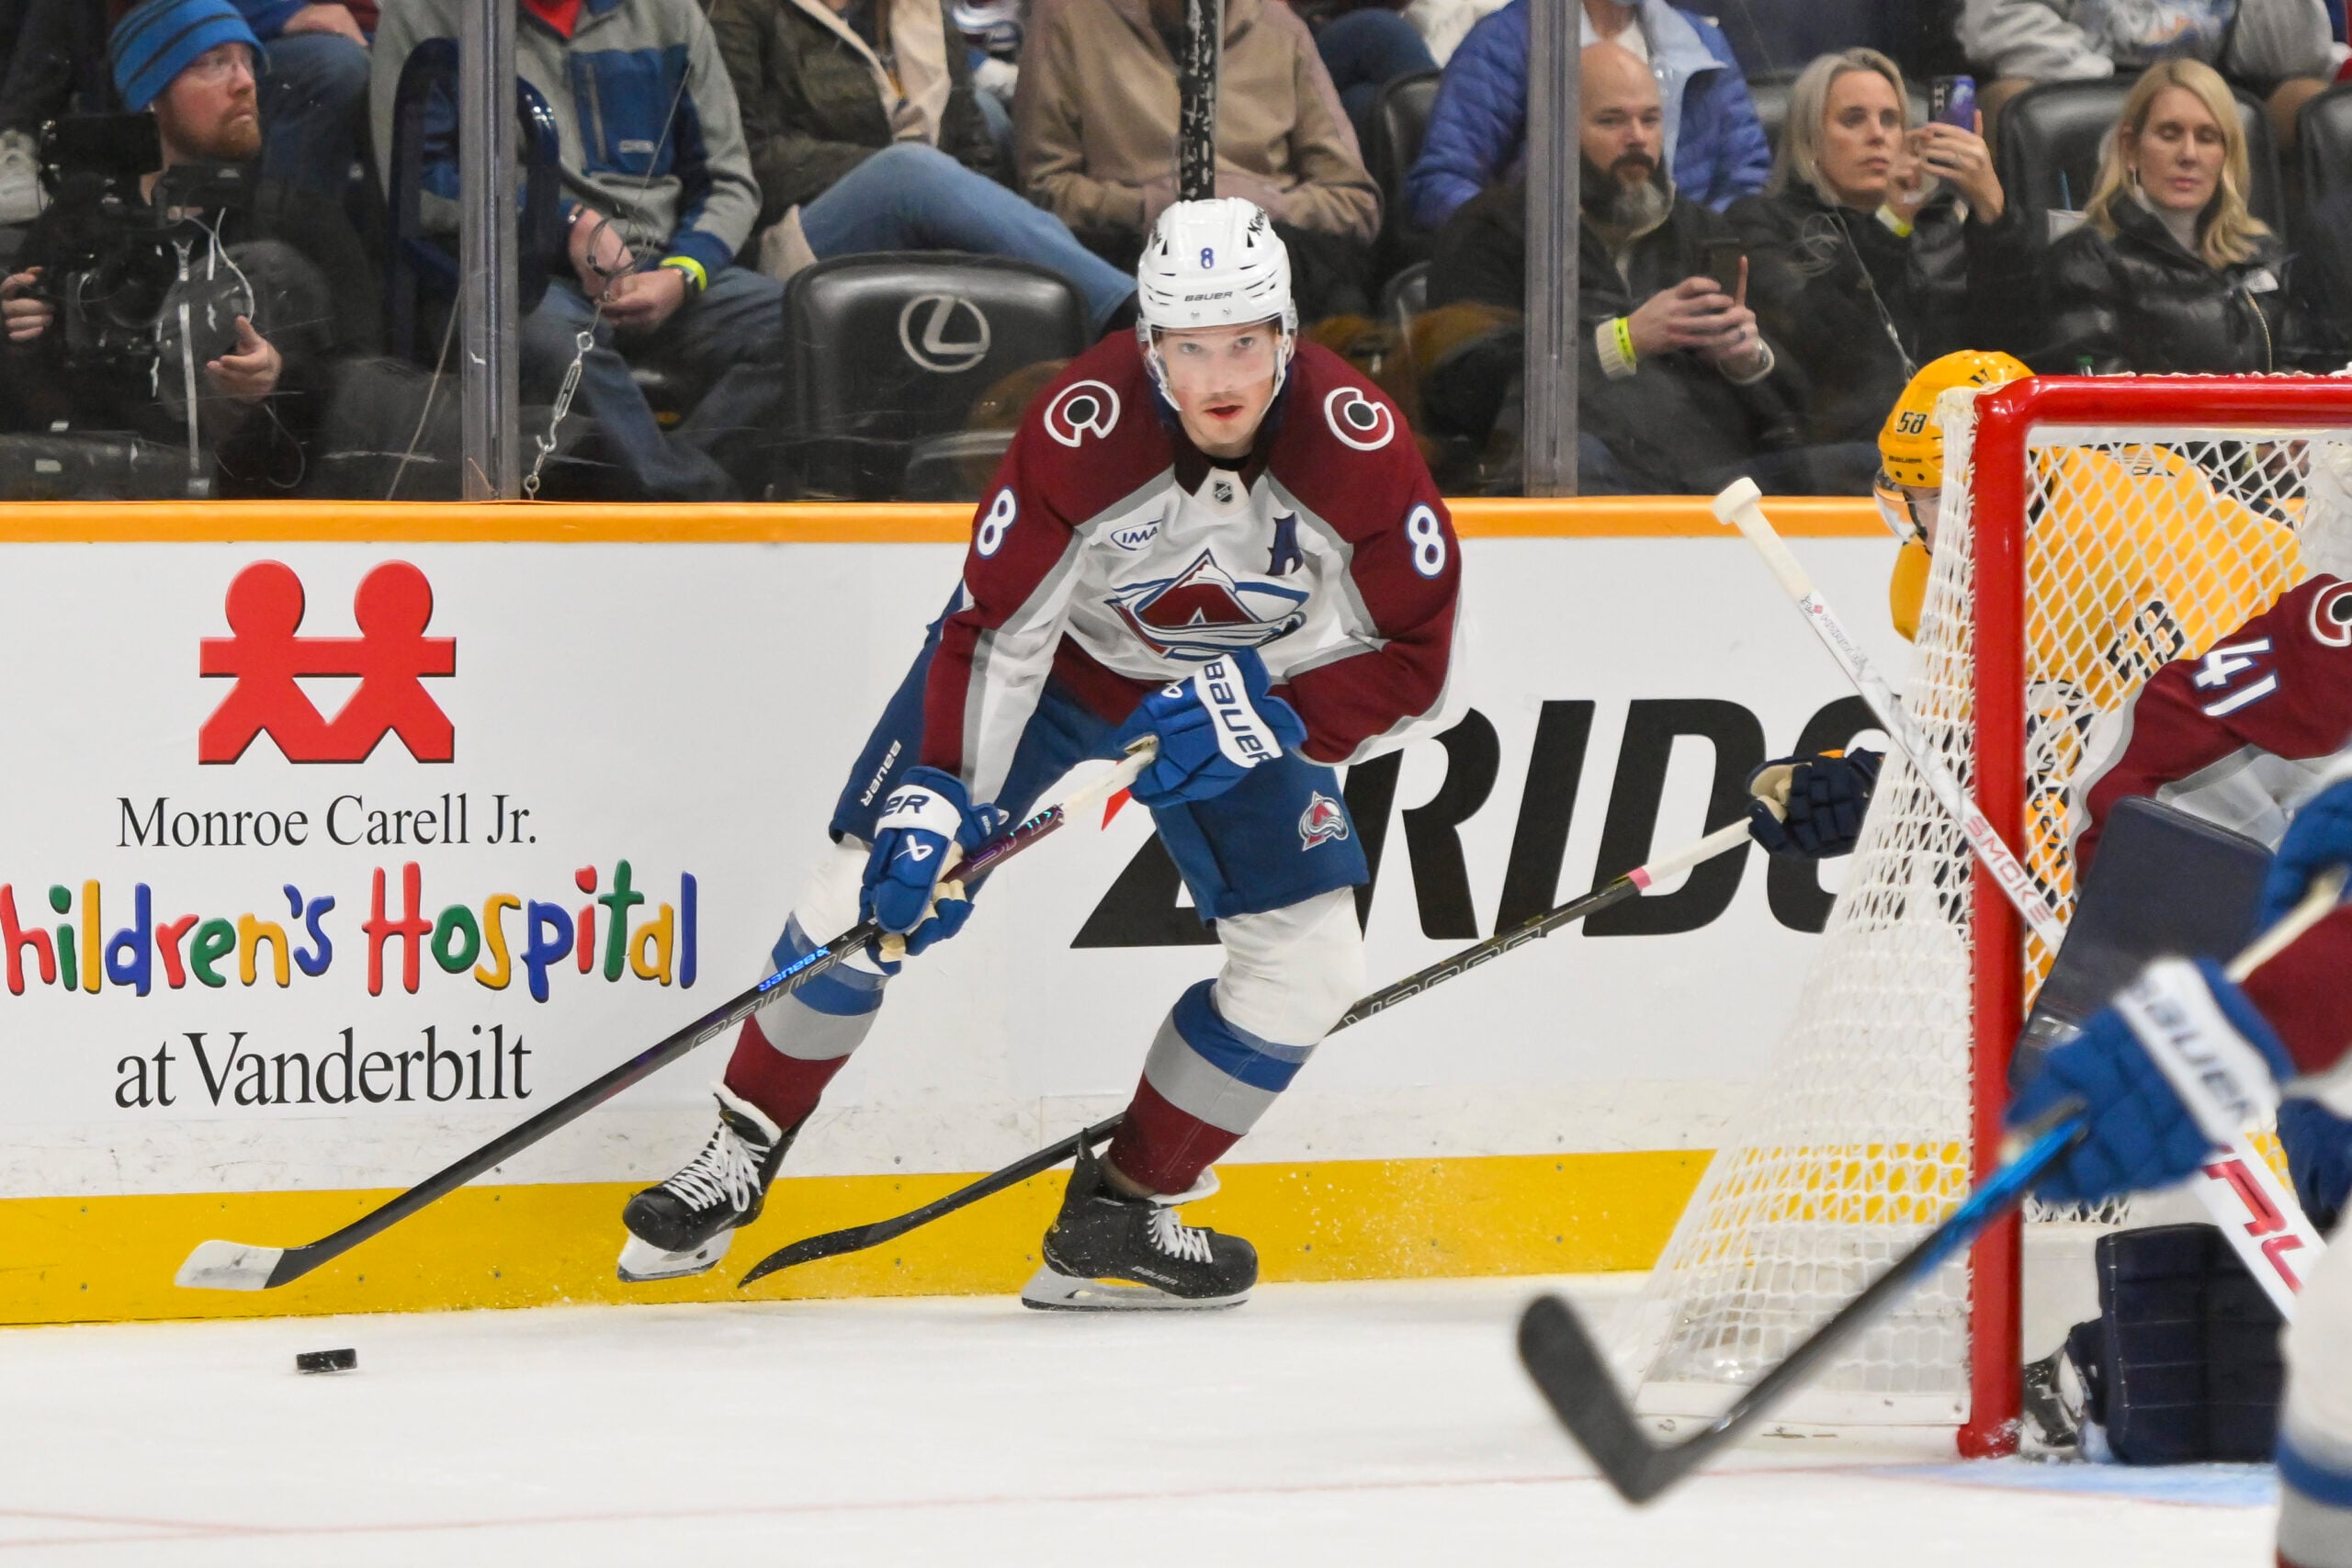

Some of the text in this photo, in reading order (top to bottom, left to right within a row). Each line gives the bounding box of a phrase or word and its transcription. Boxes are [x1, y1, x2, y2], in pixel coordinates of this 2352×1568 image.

[1201, 247, 1214, 269] 8
[1185, 291, 1233, 301] BAUER
[1896, 412, 1927, 434] 58
[977, 486, 1018, 560] 8
[1265, 511, 1304, 576] A
[1405, 502, 1447, 579] 8
[2194, 634, 2279, 719] 41
[860, 739, 902, 807] BAUER
[116, 794, 537, 848] Monroe Carell Jr.
[1965, 815, 2056, 924] SMOKE
[362, 860, 697, 1004] Hospital
[116, 1023, 533, 1109] at Vanderbilt
